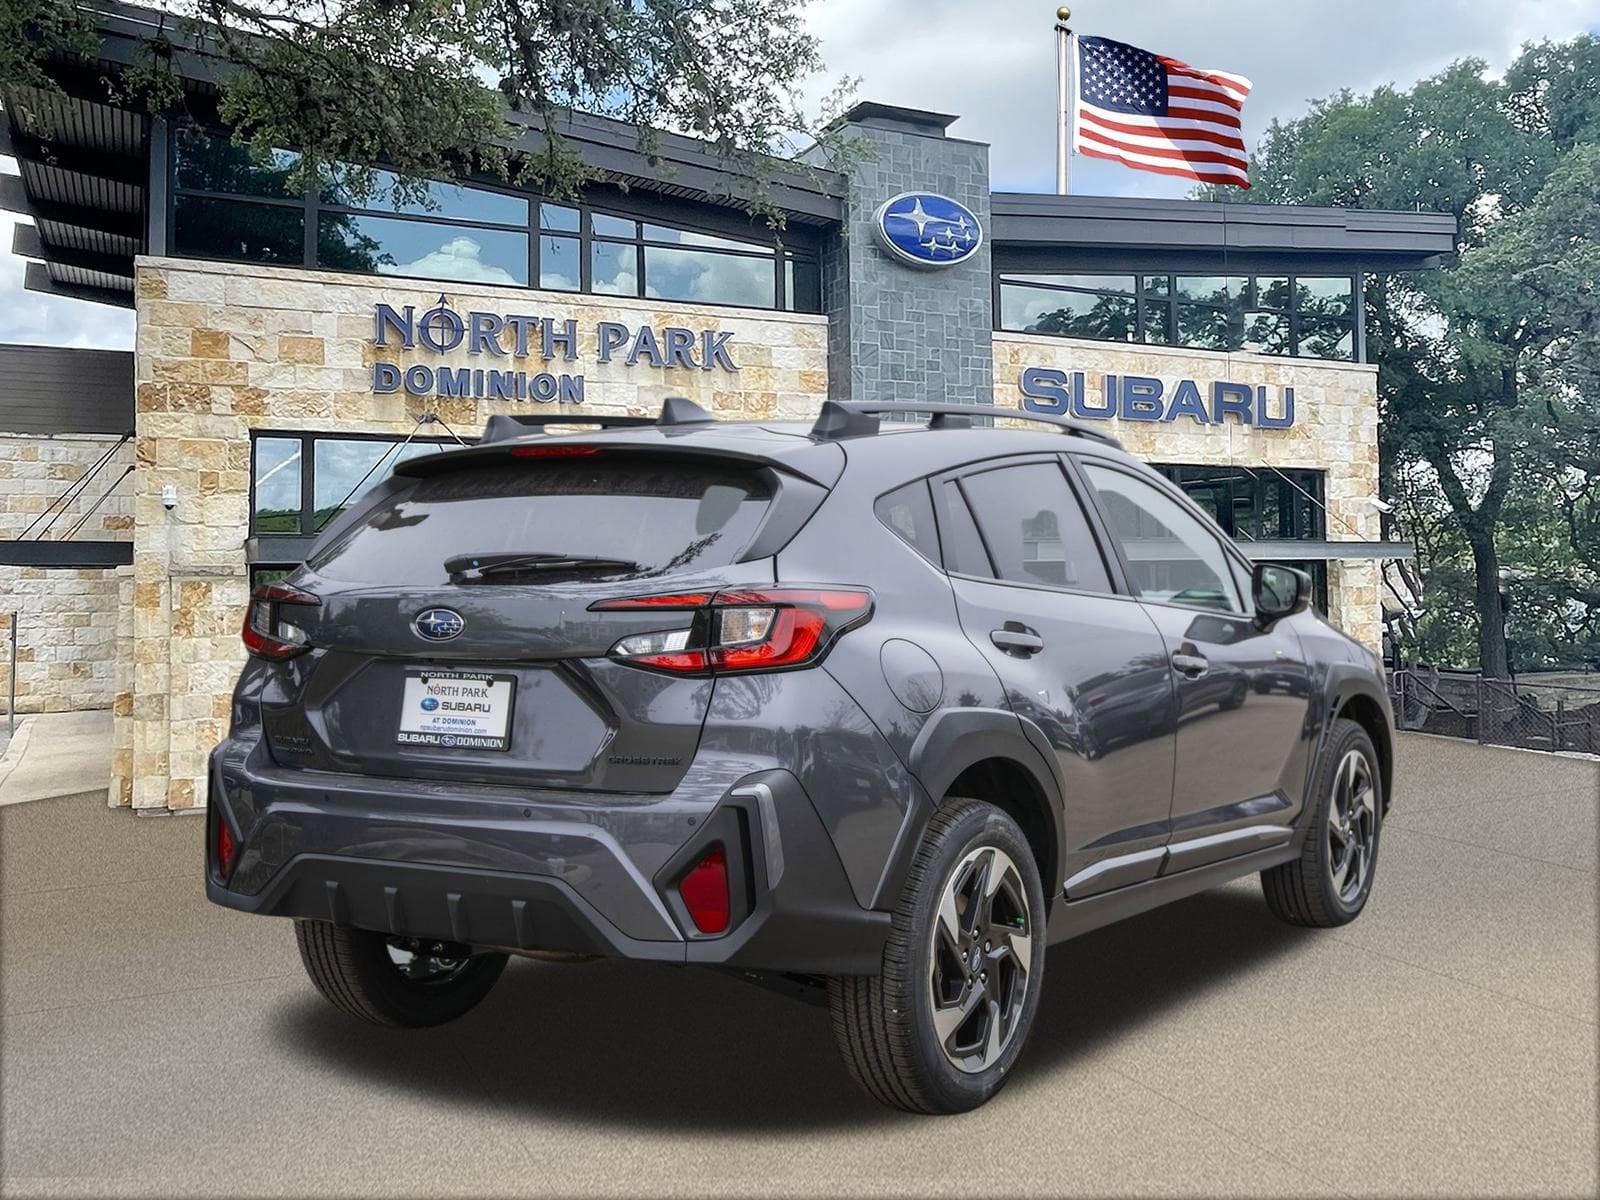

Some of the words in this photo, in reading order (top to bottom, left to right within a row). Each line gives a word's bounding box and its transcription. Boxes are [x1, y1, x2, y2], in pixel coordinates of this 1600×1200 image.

[374, 300, 578, 361] NORTH
[597, 321, 741, 372] PARK
[373, 362, 585, 403] DOMINION
[1019, 367, 1294, 429] SUBARU
[420, 671, 459, 680] NORTH
[463, 673, 494, 681] PARK
[427, 684, 459, 697] NORTH
[461, 687, 489, 698] PARK
[441, 701, 491, 713] SUBARU
[442, 718, 476, 726] DOMINION
[397, 733, 440, 744] SUBARU
[456, 737, 504, 748] DOMINION
